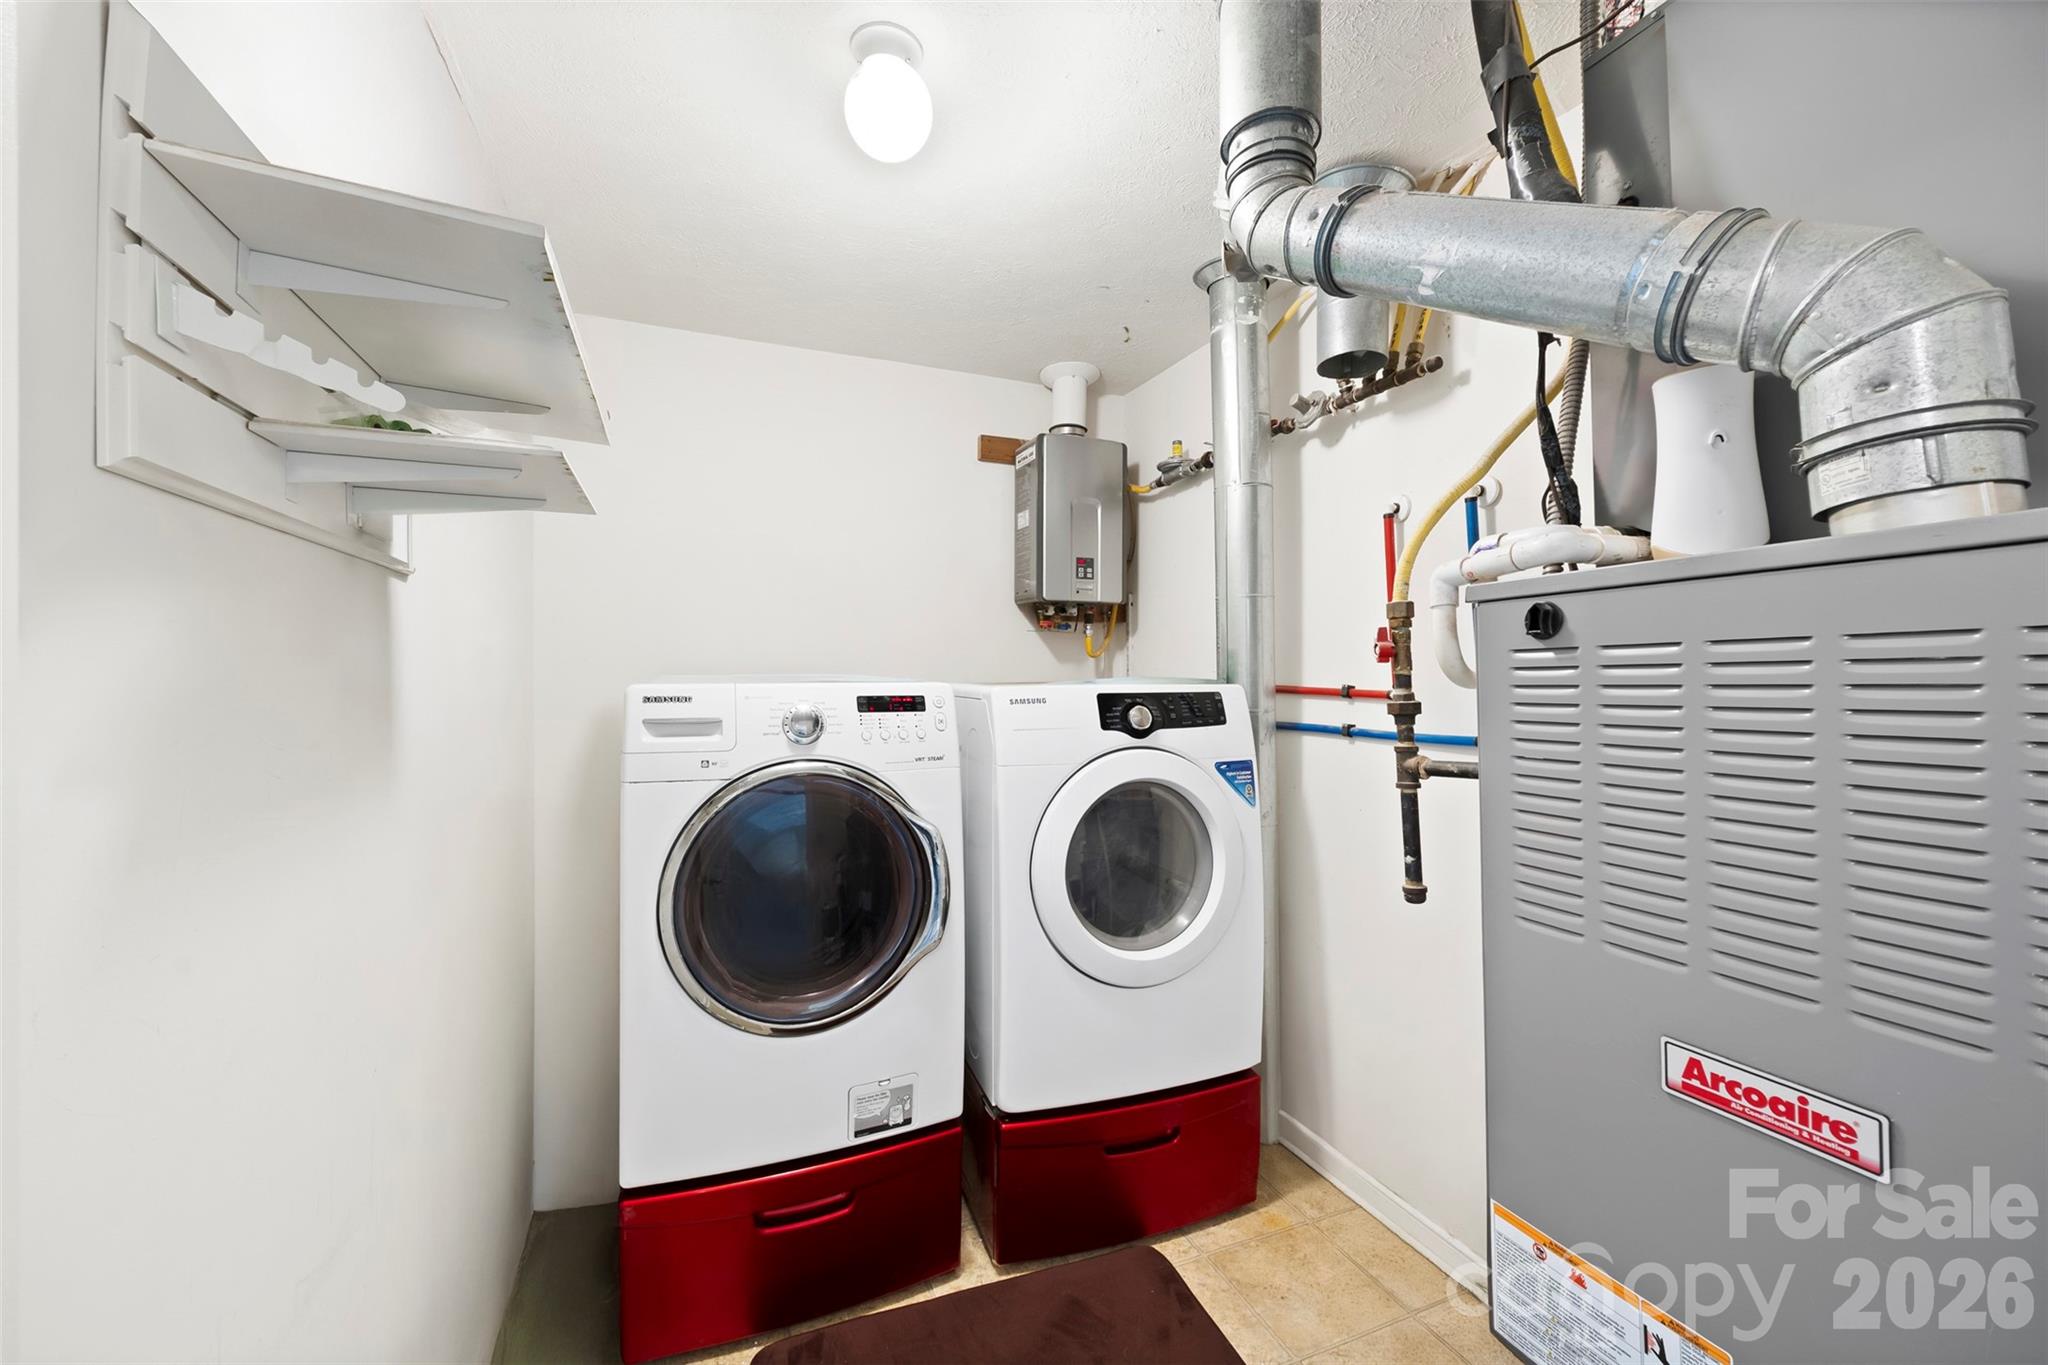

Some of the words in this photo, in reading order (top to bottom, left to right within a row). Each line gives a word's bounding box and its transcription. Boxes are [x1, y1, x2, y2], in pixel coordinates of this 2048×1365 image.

[642, 695, 693, 704] SAMSUNG
[1681, 1056, 1858, 1145] Arcoaire
[1730, 1101, 1744, 1112] Air
[1744, 1106, 1800, 1137] Conditioning
[1802, 1129, 1811, 1140] &
[1812, 1133, 1852, 1158] Heating
